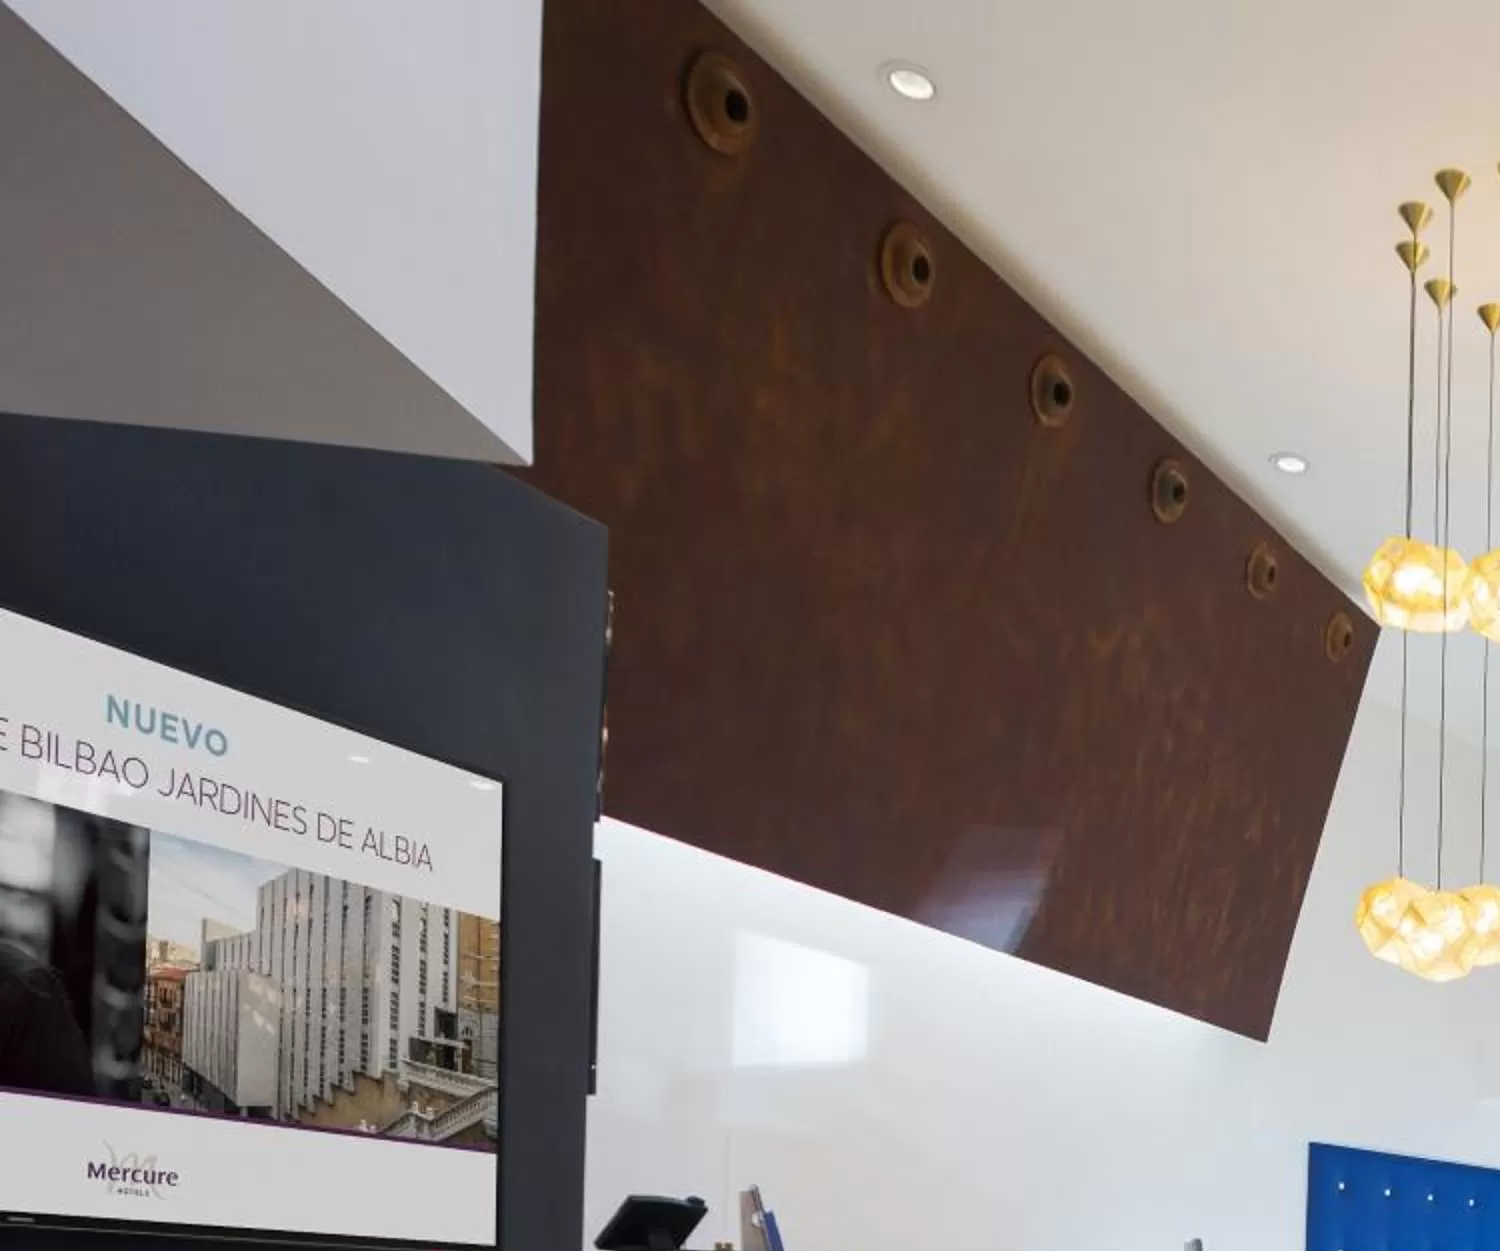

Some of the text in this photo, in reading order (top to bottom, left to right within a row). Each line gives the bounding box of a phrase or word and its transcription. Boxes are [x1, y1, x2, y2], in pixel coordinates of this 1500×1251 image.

[106, 694, 229, 757] NUEVO
[21, 724, 149, 789] BILBAO
[157, 767, 308, 836] JARDINES
[317, 812, 354, 850] DE
[361, 827, 433, 872] ALBIA
[87, 1161, 180, 1187] Mercure
